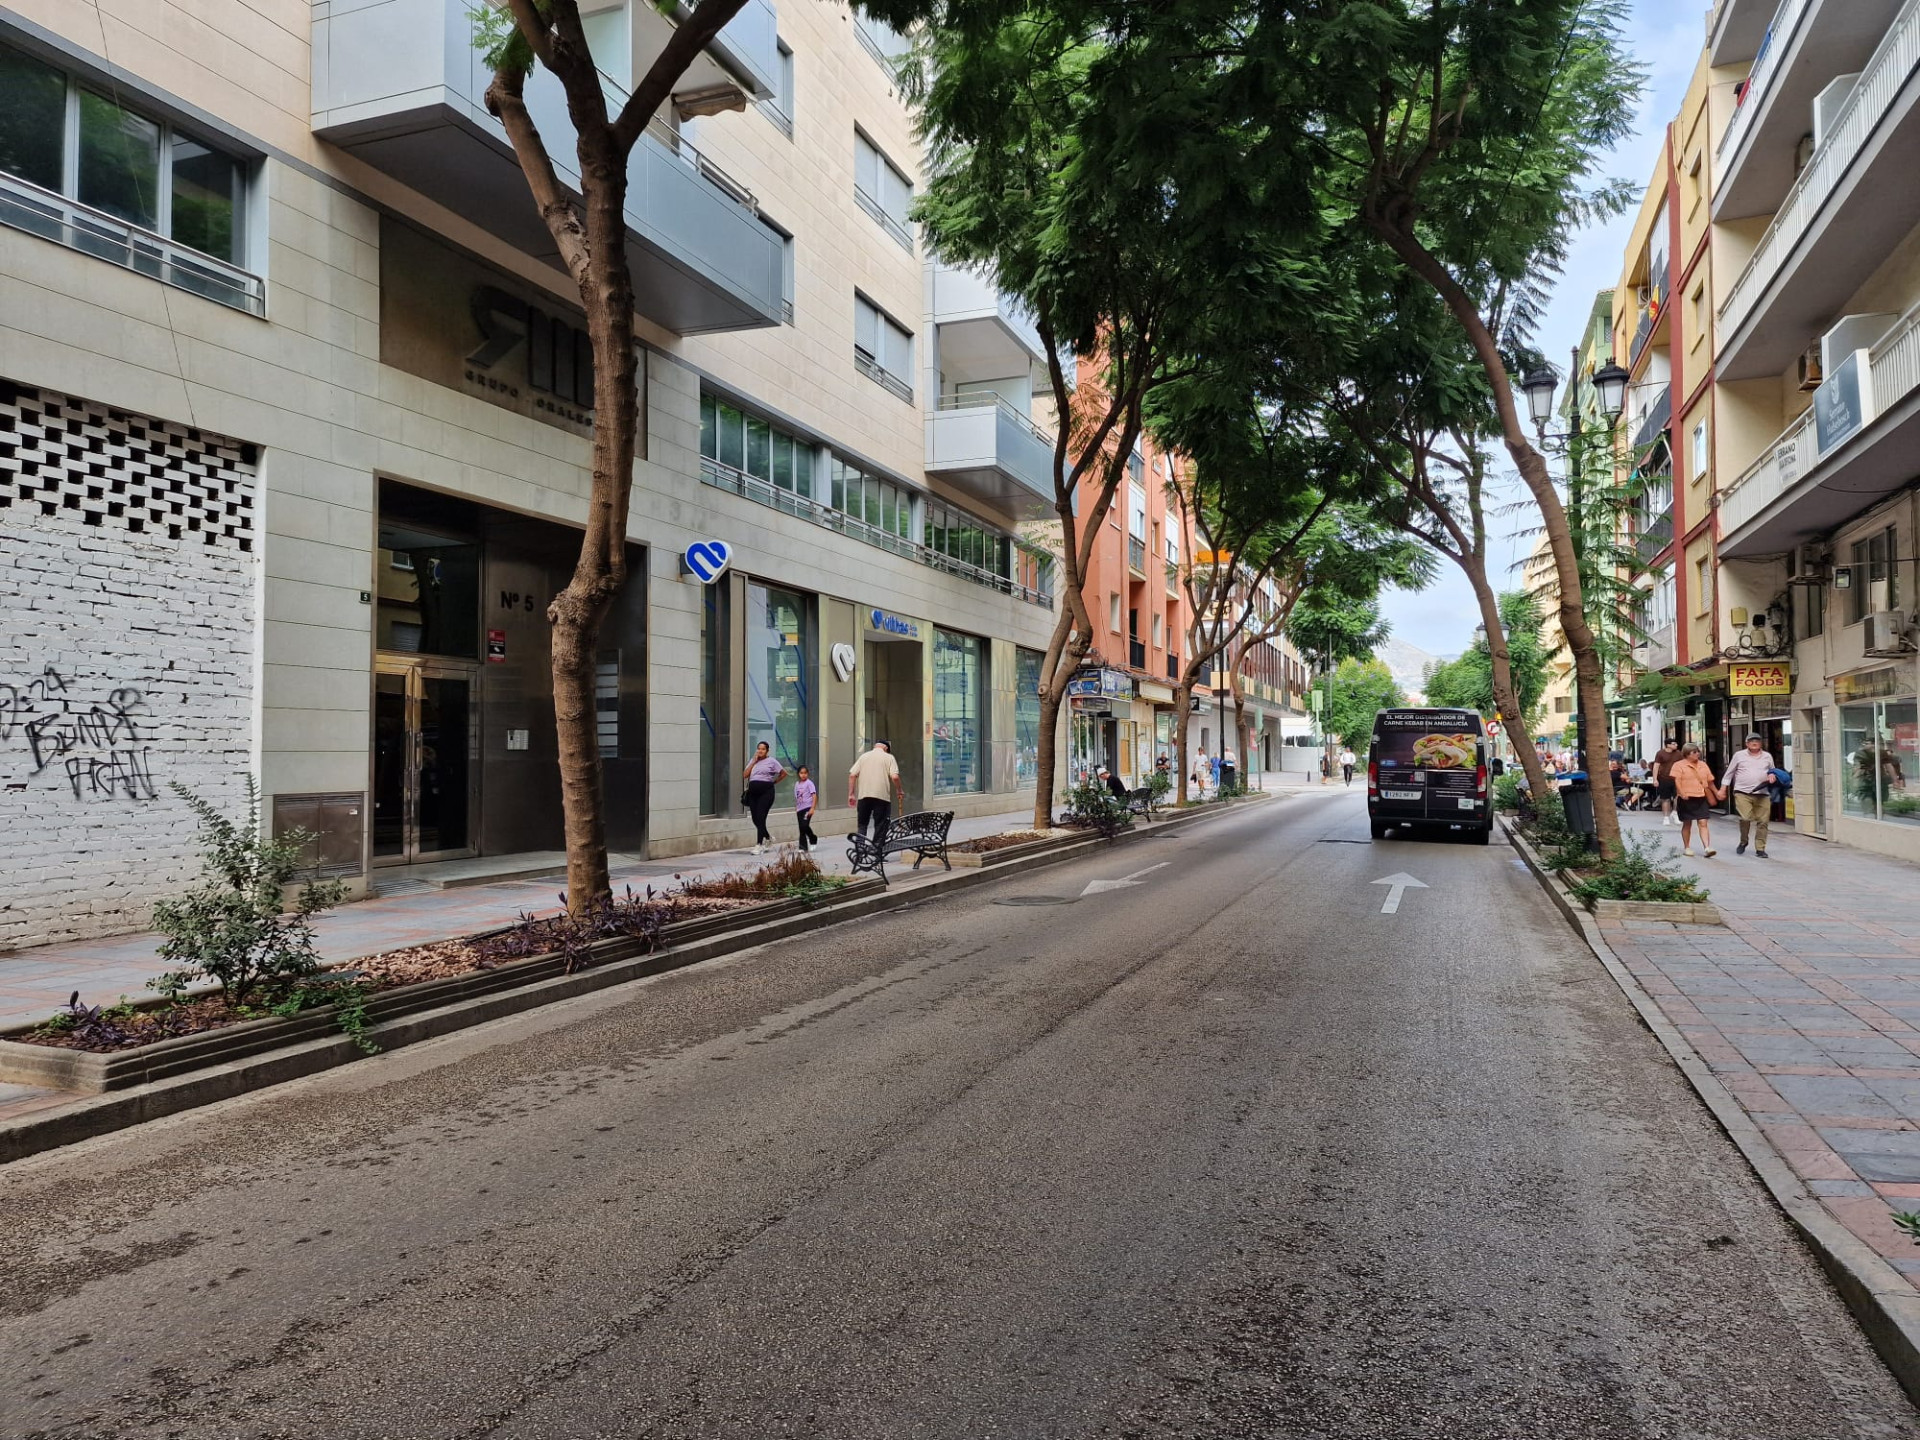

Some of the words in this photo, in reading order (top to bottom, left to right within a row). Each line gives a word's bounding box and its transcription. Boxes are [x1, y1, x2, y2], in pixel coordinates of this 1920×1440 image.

[465, 370, 519, 398] GRUPO
[524, 595, 534, 612] 5
[1736, 667, 1783, 678] FAFA
[1736, 678, 1784, 687] FOODS
